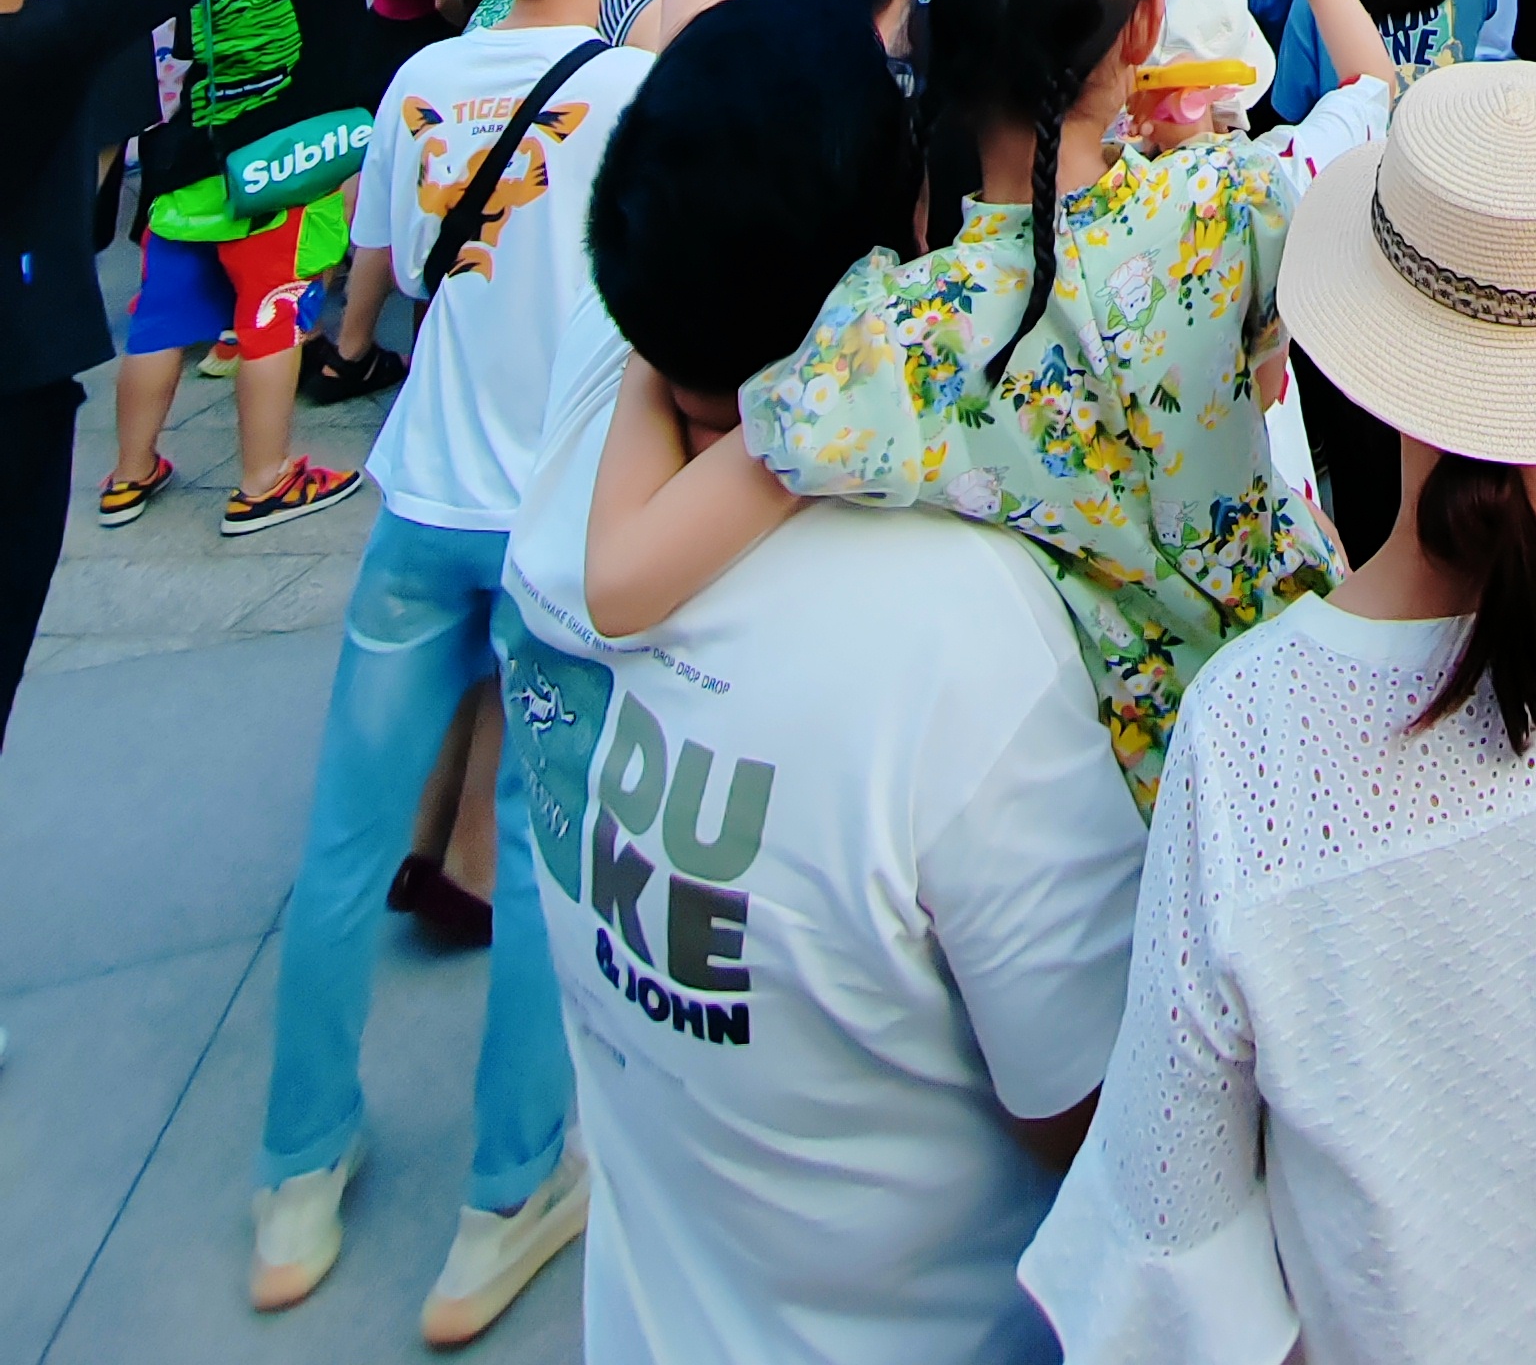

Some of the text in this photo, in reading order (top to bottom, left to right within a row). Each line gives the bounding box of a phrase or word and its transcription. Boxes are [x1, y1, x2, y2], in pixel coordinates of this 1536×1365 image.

[242, 125, 373, 194] Subtle
[675, 661, 701, 683] DROP
[700, 674, 731, 695] DROP
[625, 965, 750, 1045] JOHN
